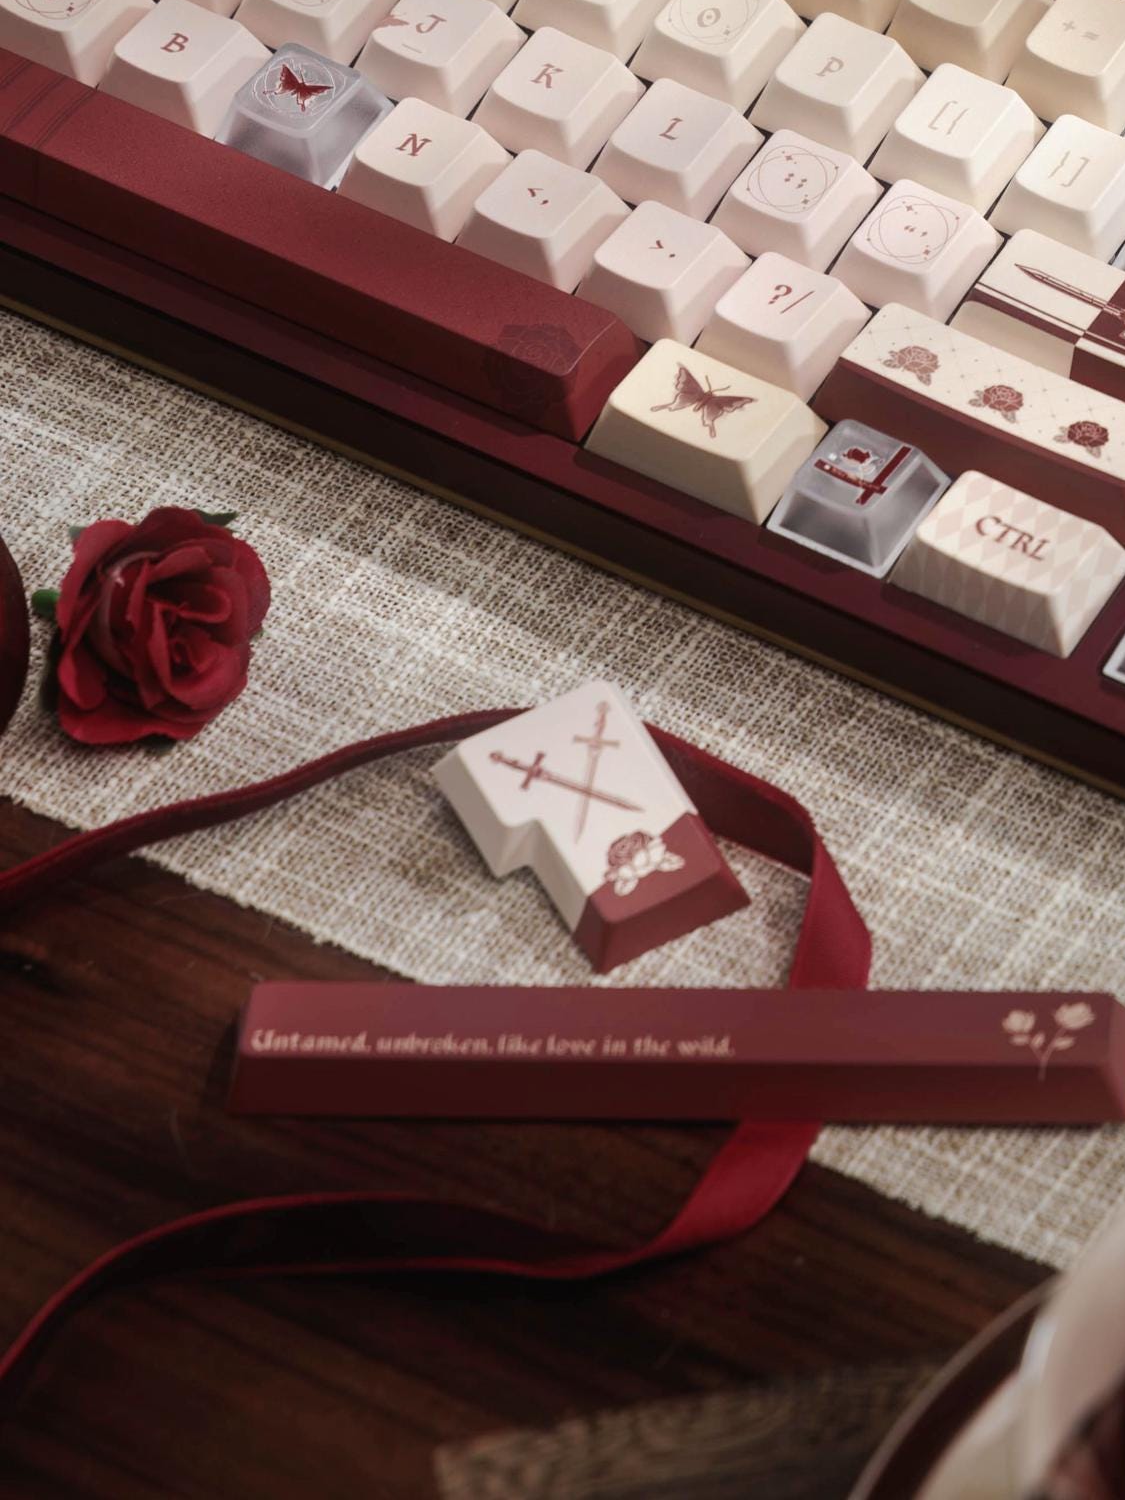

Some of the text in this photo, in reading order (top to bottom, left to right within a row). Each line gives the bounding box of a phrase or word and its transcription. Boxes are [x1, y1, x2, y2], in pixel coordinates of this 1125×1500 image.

[414, 12, 447, 35] J
[161, 31, 190, 55] B
[529, 62, 564, 89] K
[815, 55, 845, 79] P
[659, 116, 685, 140] L
[396, 132, 432, 157] N
[975, 514, 1051, 562] CTRL
[497, 1033, 543, 1056] like
[545, 1033, 597, 1056] love
[602, 1034, 627, 1056] in
[632, 1034, 673, 1057] the
